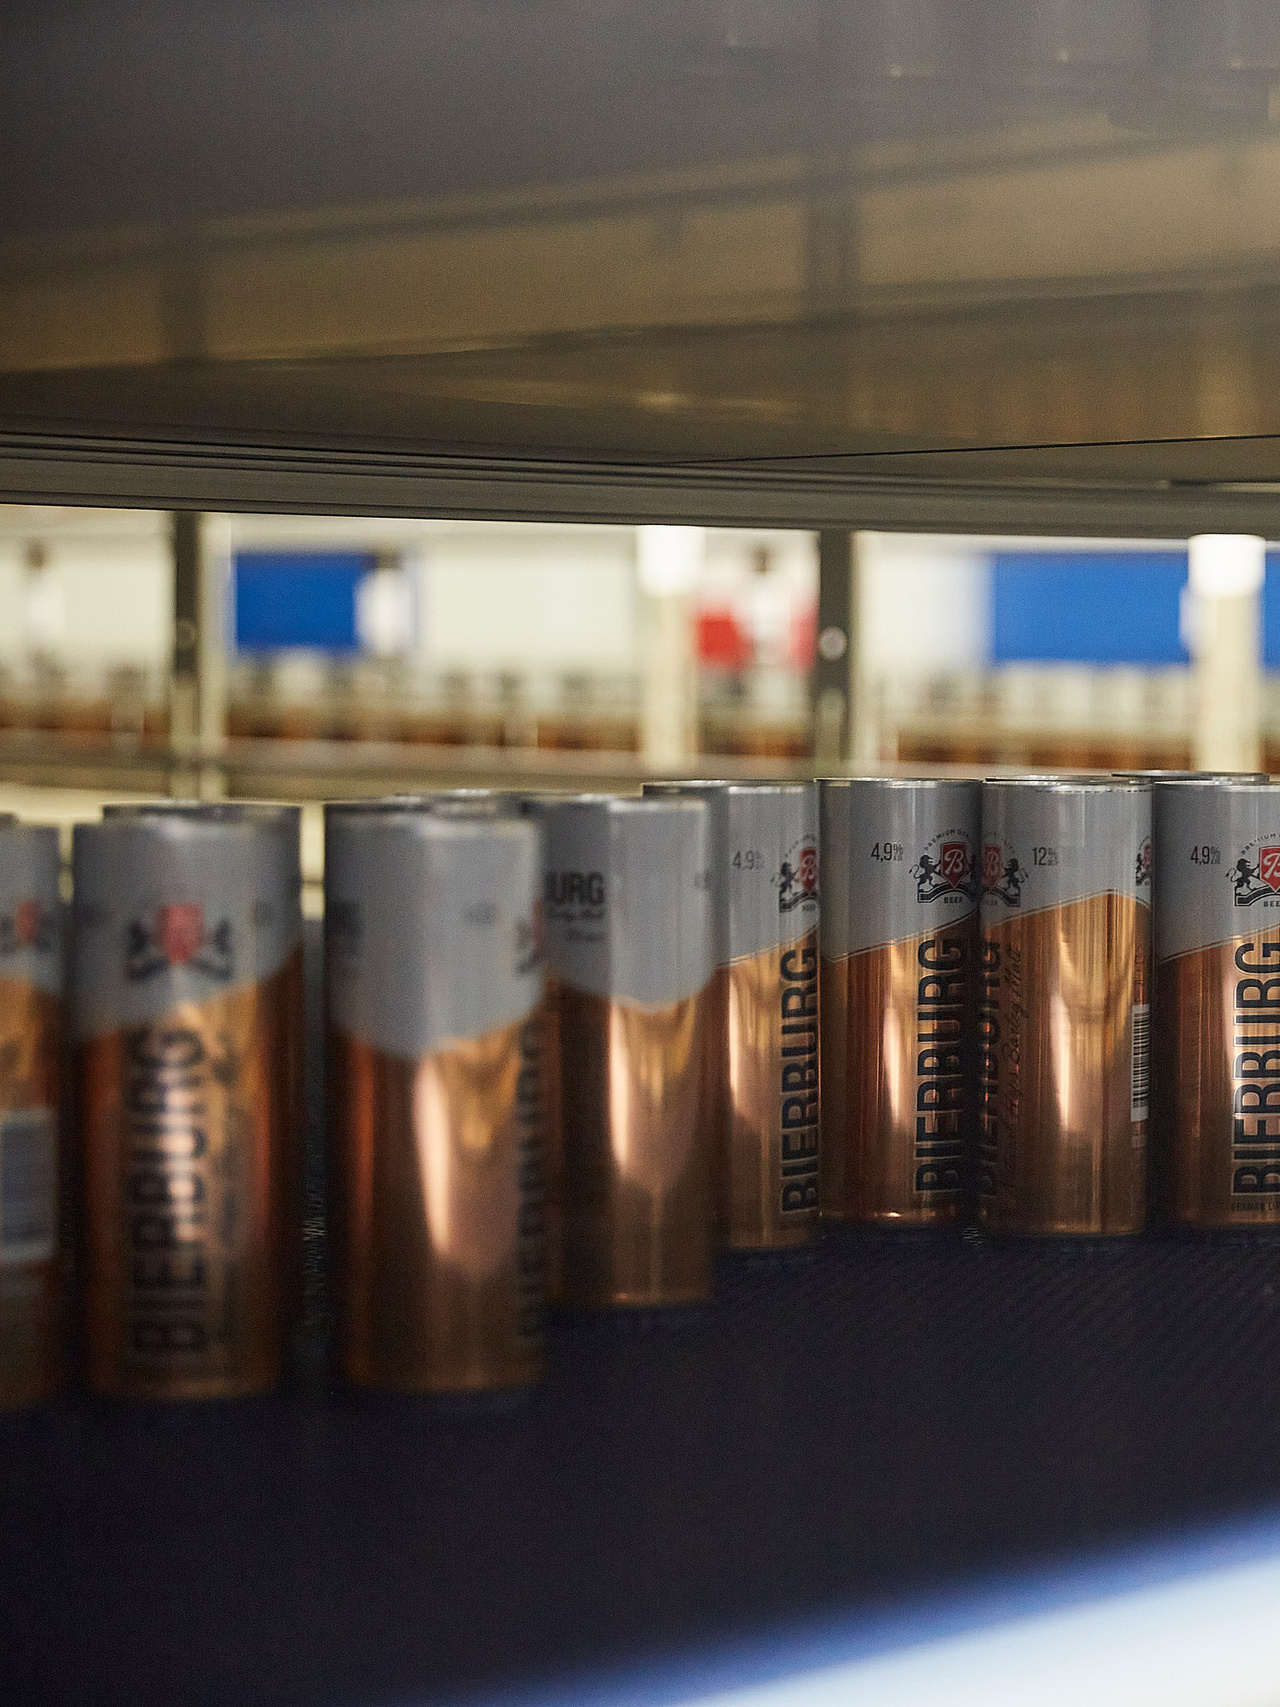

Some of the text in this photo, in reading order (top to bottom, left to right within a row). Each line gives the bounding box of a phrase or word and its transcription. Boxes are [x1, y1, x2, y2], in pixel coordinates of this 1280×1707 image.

[1241, 833, 1277, 855] PREMIUM
[779, 948, 818, 1213] BIERBURG
[915, 938, 965, 1193] BIERBURG
